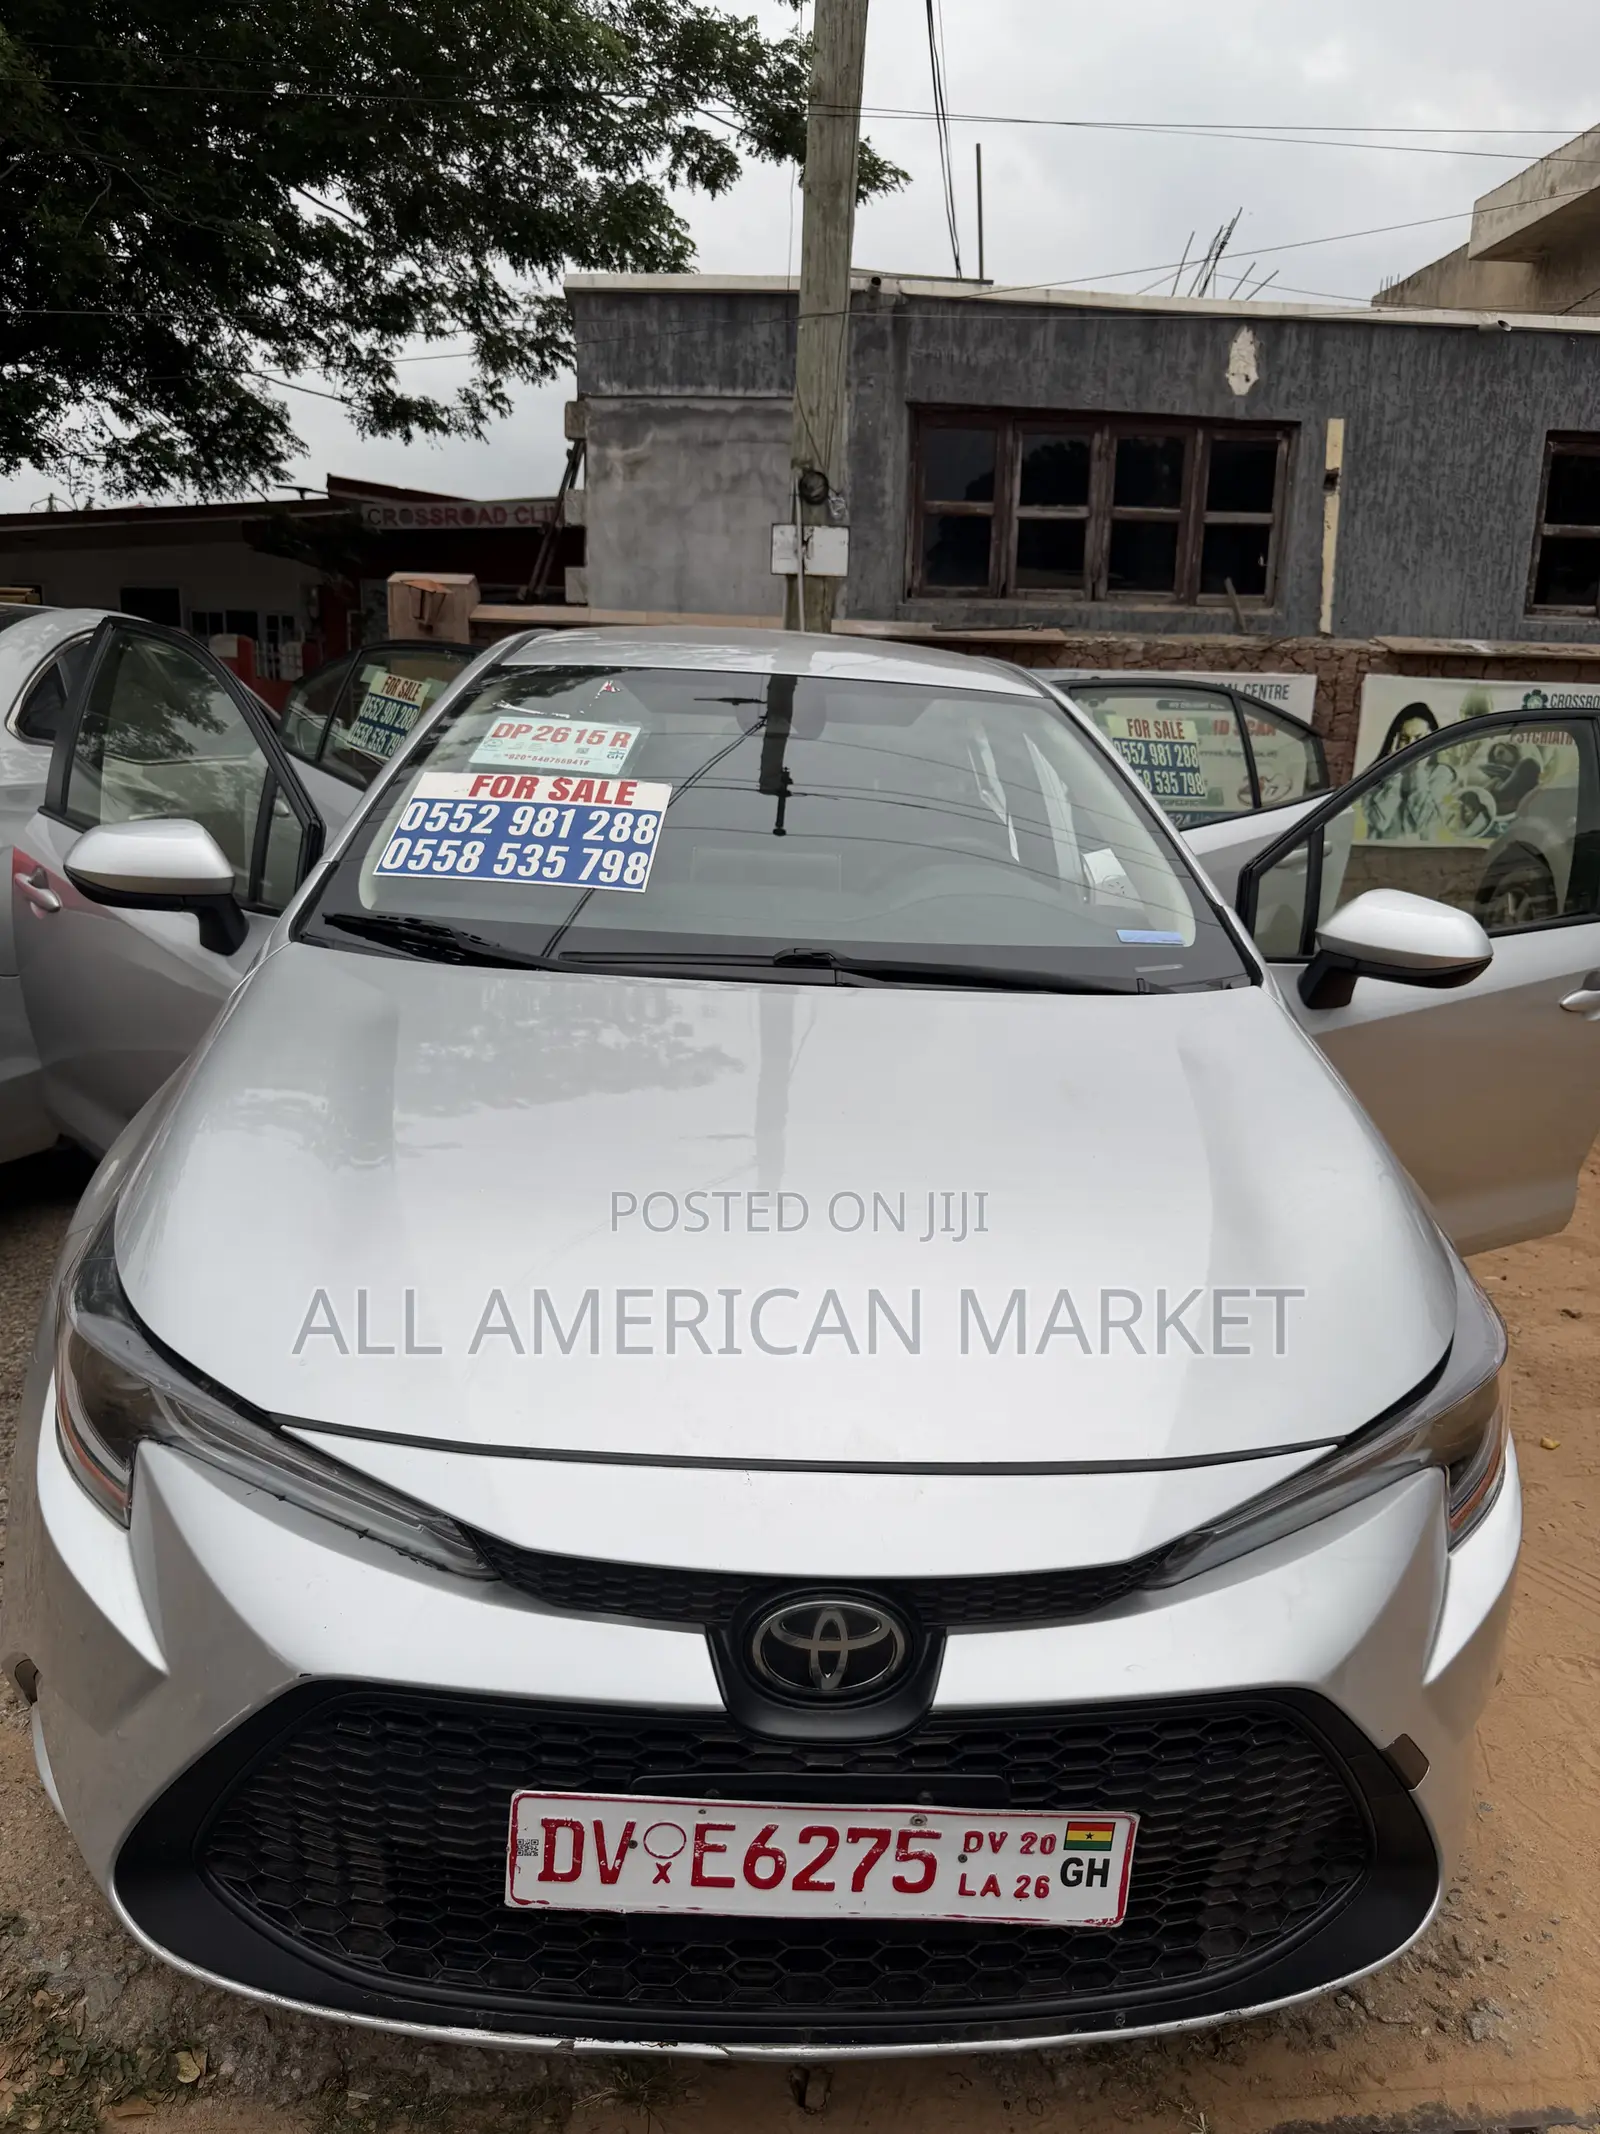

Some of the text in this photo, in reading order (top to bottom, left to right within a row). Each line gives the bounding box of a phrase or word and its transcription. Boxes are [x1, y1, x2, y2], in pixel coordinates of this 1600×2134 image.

[366, 506, 508, 526] CROSSROAD
[381, 675, 423, 702] FOR SALE
[1244, 683, 1290, 700] CENTRE
[361, 695, 419, 731] 0552 981 288
[367, 727, 390, 753] 535
[491, 722, 533, 739] DP
[608, 731, 632, 748] R
[1126, 718, 1186, 740] FOR SALE
[1148, 743, 1173, 767] 981
[1173, 745, 1200, 768] 288
[467, 774, 639, 806] FOR SALE
[1154, 770, 1179, 794] 535
[1179, 772, 1204, 795] 798
[400, 802, 659, 845] 0552 981 288
[382, 837, 651, 885] 0558 535 798
[537, 1817, 637, 1885] DV
[691, 1822, 943, 1893] E6275
[963, 1830, 1057, 1855] DV 20
[958, 1872, 1050, 1899] LA 26
[1060, 1857, 1111, 1888] GH
